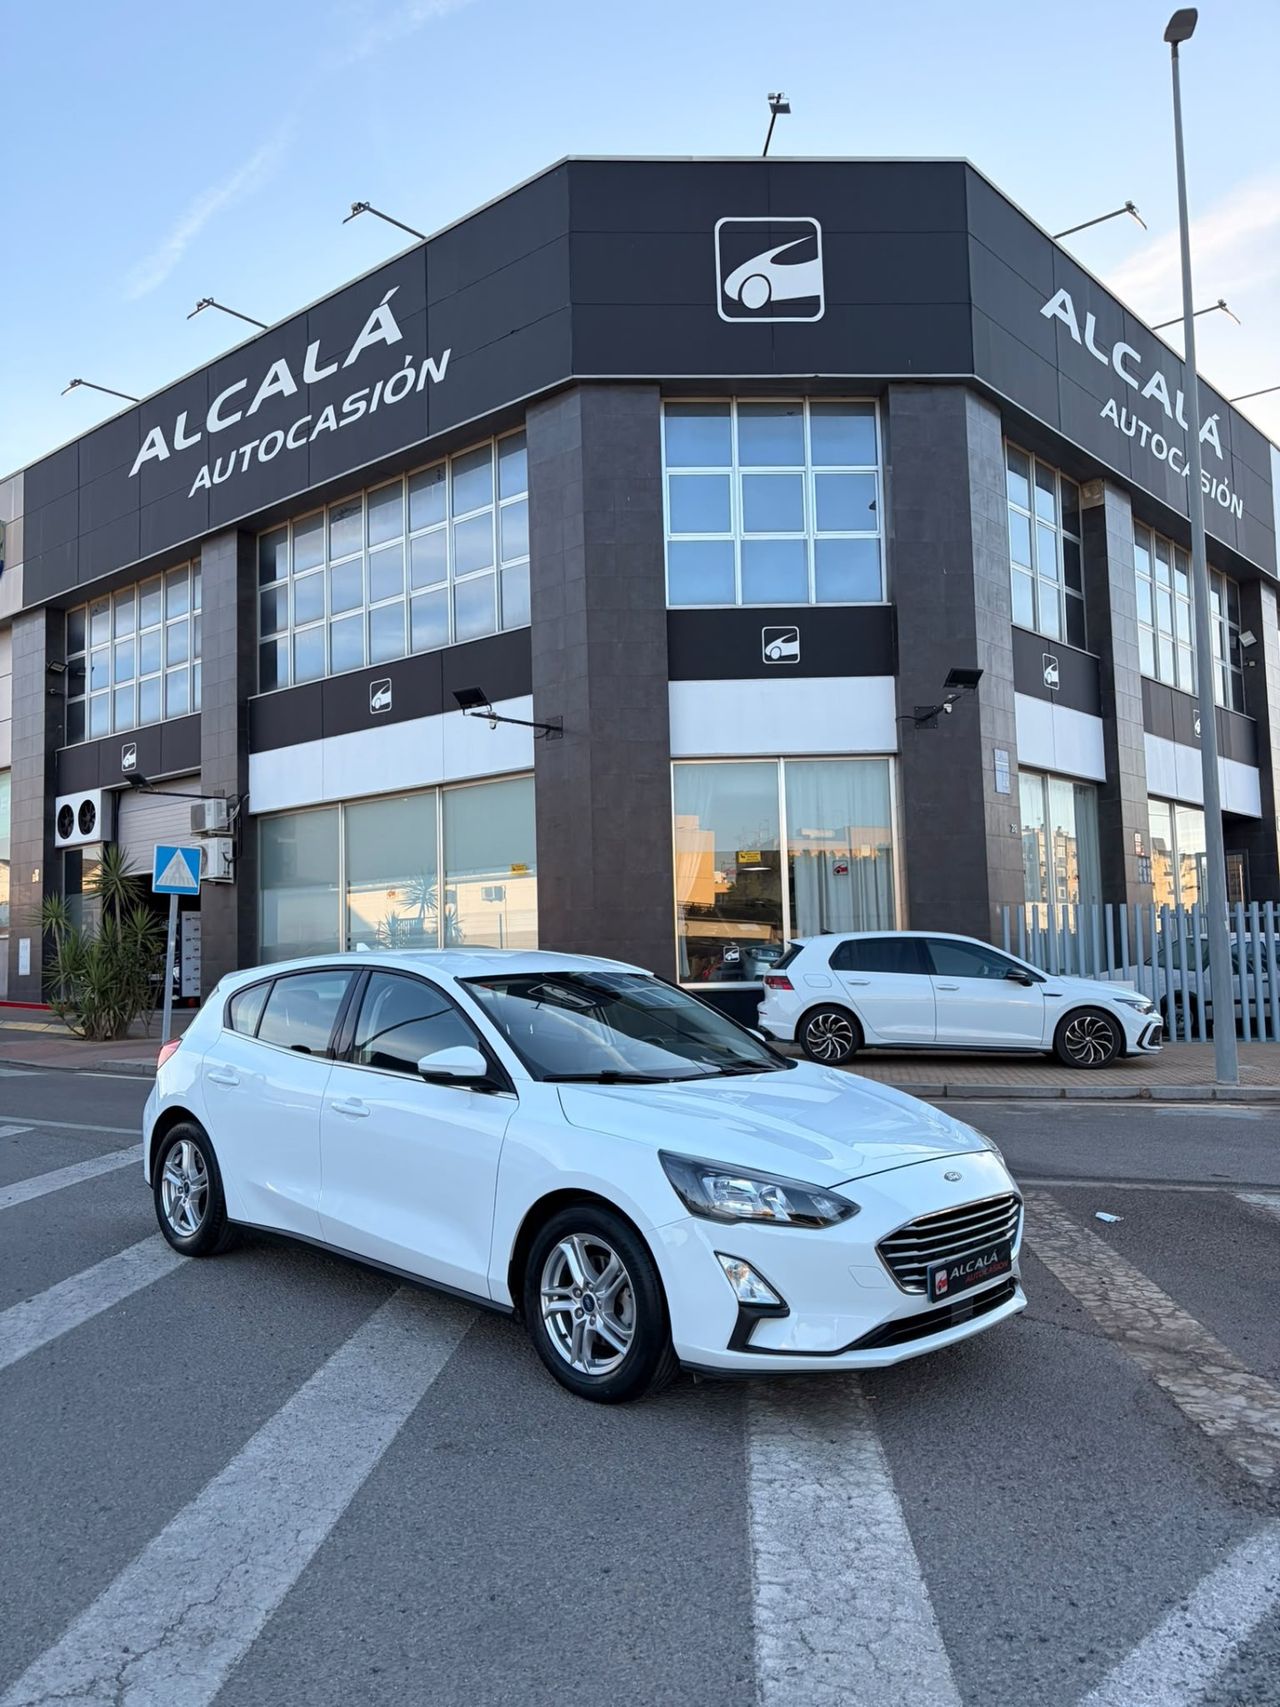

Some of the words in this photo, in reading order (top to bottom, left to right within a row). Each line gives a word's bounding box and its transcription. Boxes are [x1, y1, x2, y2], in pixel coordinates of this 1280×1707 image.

[128, 286, 403, 478] ALCALÁ
[188, 348, 452, 499] AUTOCASIÓN
[1040, 288, 1223, 461] ALCALÁ
[949, 1249, 998, 1280] ALCALÁ
